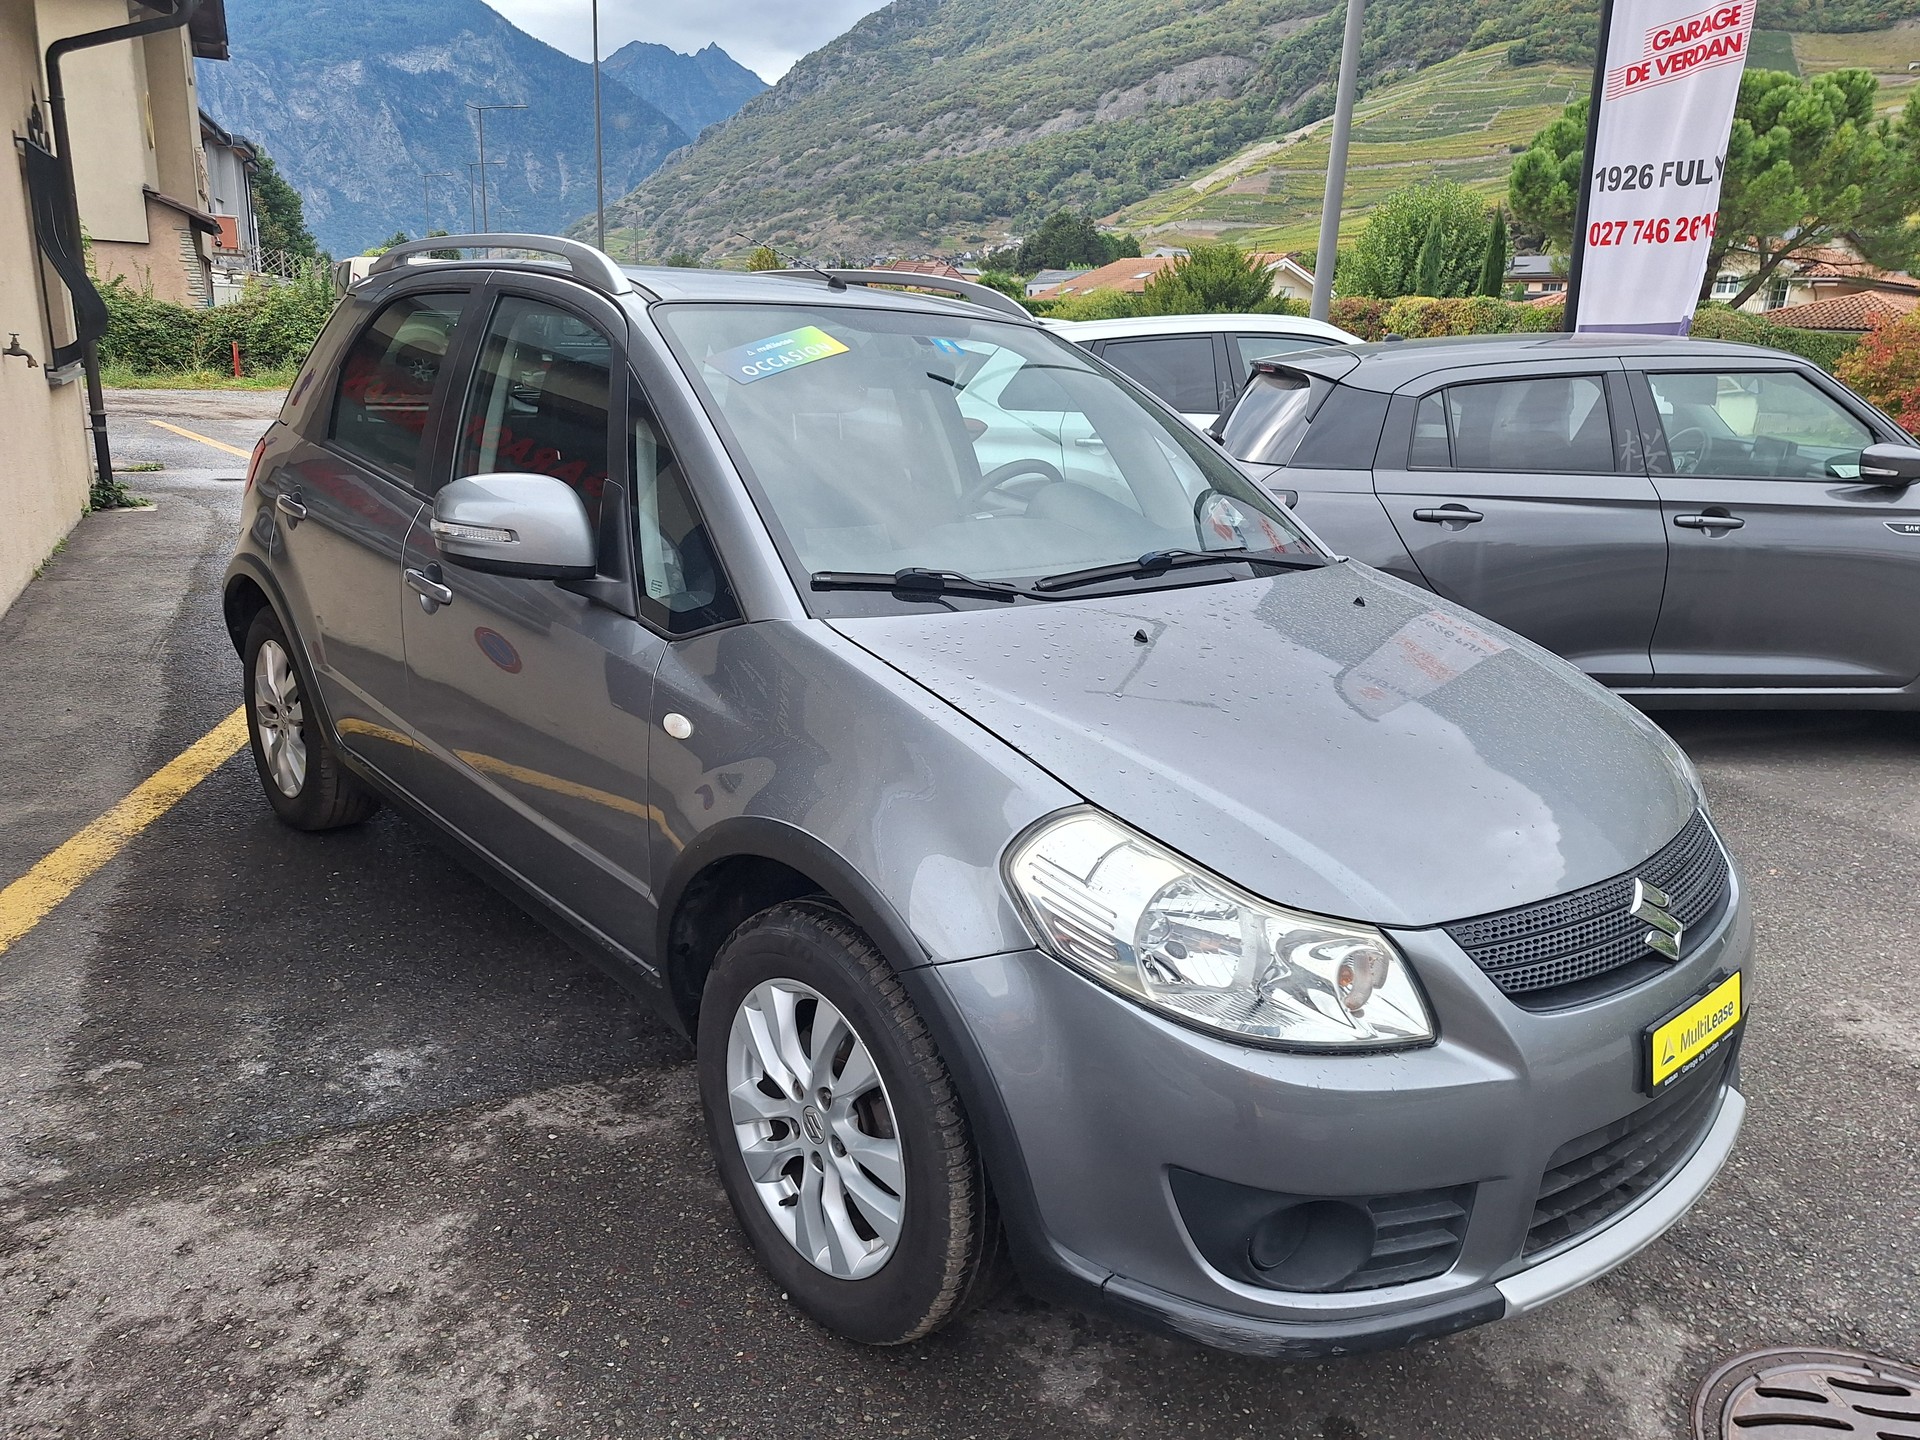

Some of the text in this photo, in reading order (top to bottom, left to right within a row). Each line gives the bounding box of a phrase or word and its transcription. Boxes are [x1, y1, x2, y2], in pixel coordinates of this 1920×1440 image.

[1652, 5, 1742, 51] GARAGE
[1625, 33, 1742, 87] DE VERDAN
[1595, 164, 1654, 193] 1926
[1589, 221, 1628, 247] 027
[1632, 218, 1670, 245] 746
[741, 342, 833, 376] OCCASION
[1680, 1001, 1734, 1053] MultiLease
